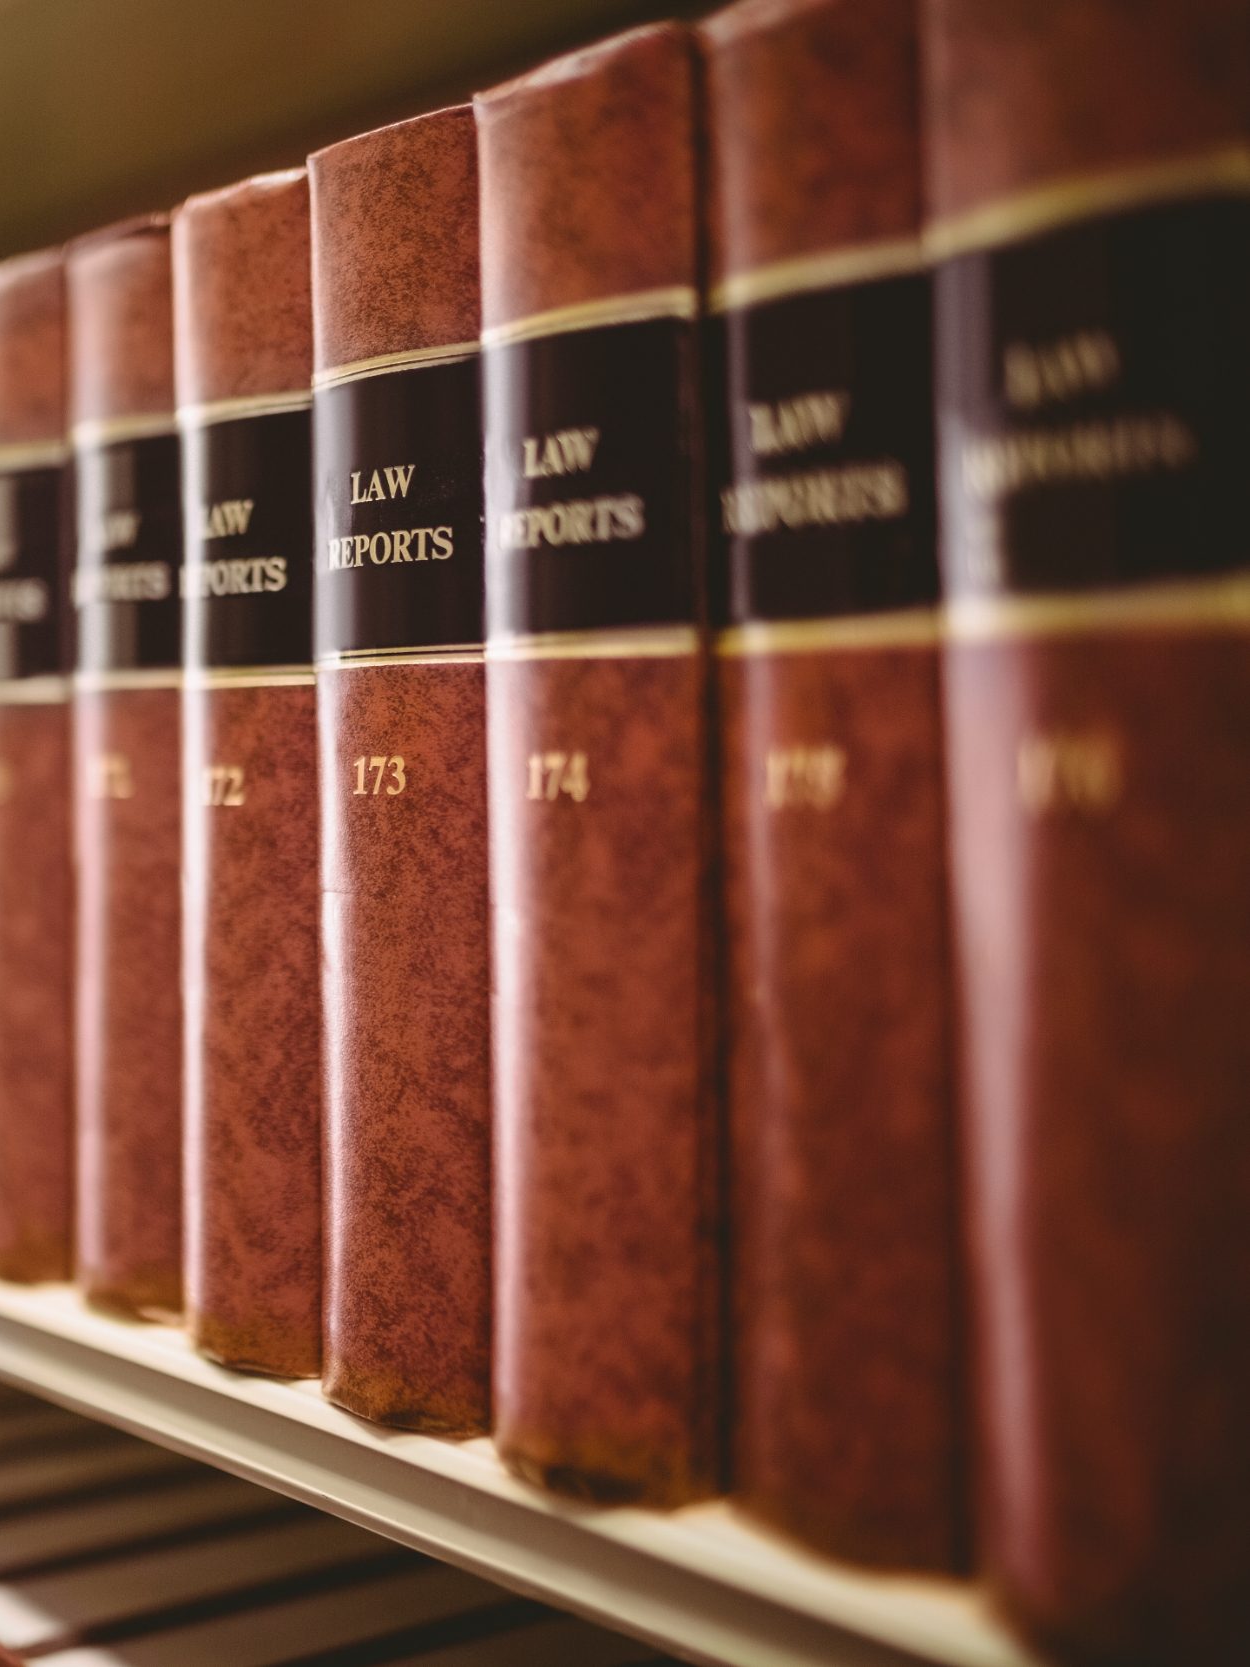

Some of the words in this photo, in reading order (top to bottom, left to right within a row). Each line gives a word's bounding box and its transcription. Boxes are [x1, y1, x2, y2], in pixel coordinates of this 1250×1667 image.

[523, 426, 599, 478] LAW
[350, 464, 415, 505] LAW
[328, 526, 454, 570] REPORTS
[180, 556, 288, 599] PORTS
[201, 766, 244, 806] 72
[353, 755, 406, 795] 173
[526, 751, 590, 802] 174
